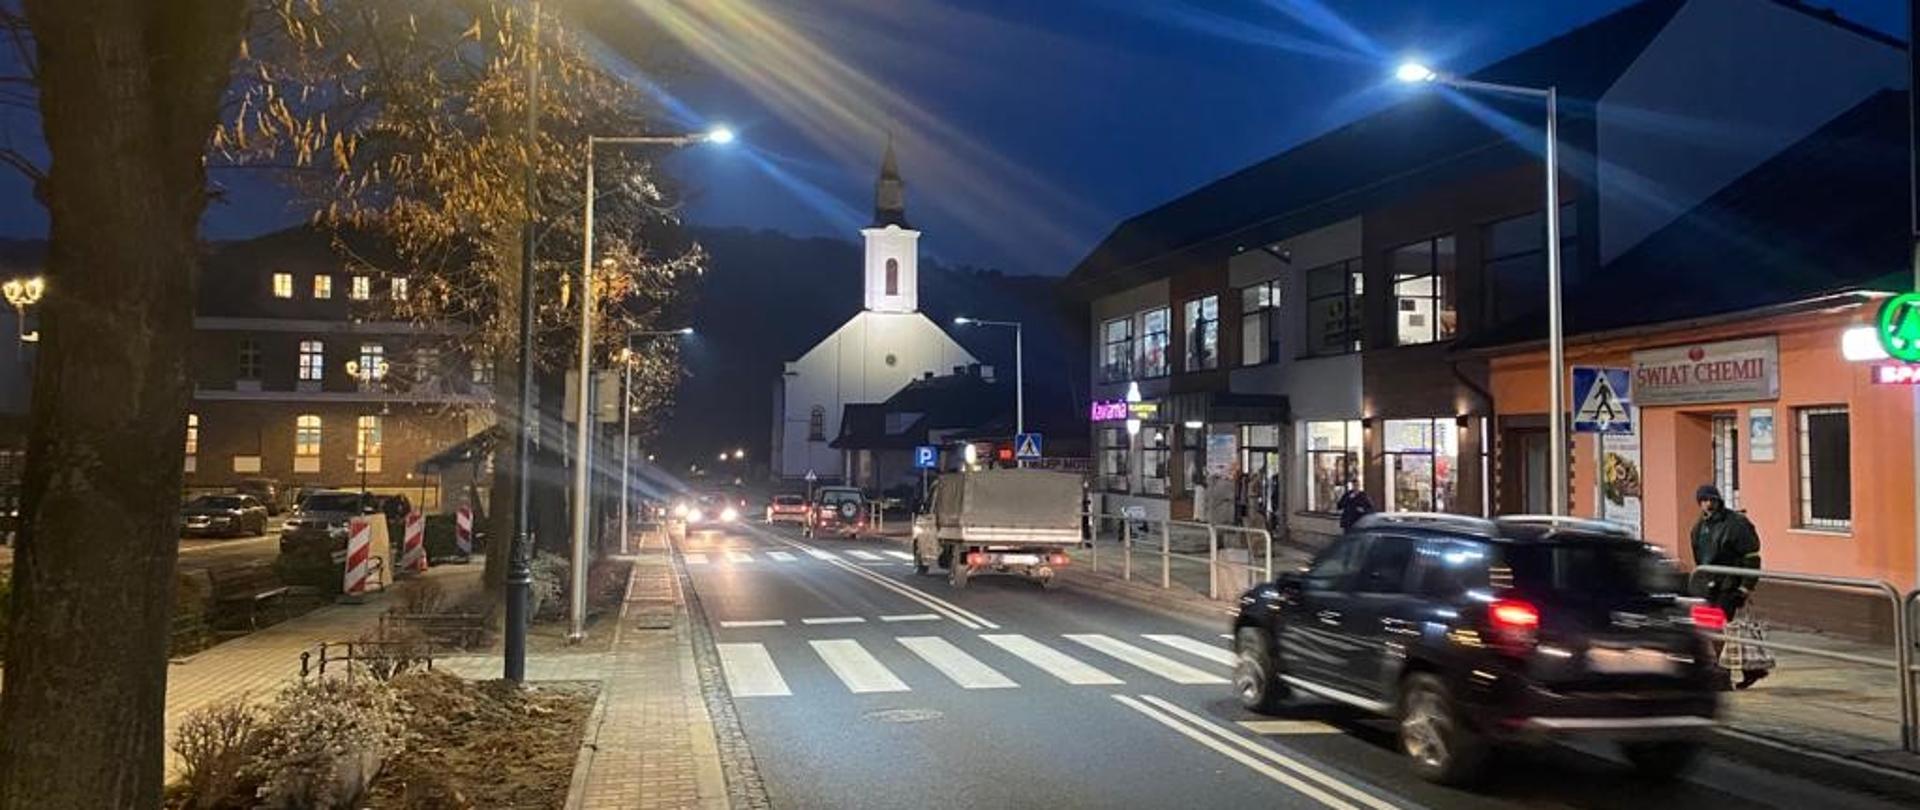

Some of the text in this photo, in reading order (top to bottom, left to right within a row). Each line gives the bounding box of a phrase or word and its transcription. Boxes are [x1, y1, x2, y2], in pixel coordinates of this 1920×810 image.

[1636, 358, 1764, 386] ŚWIAT CHEMII
[920, 447, 932, 465] P
